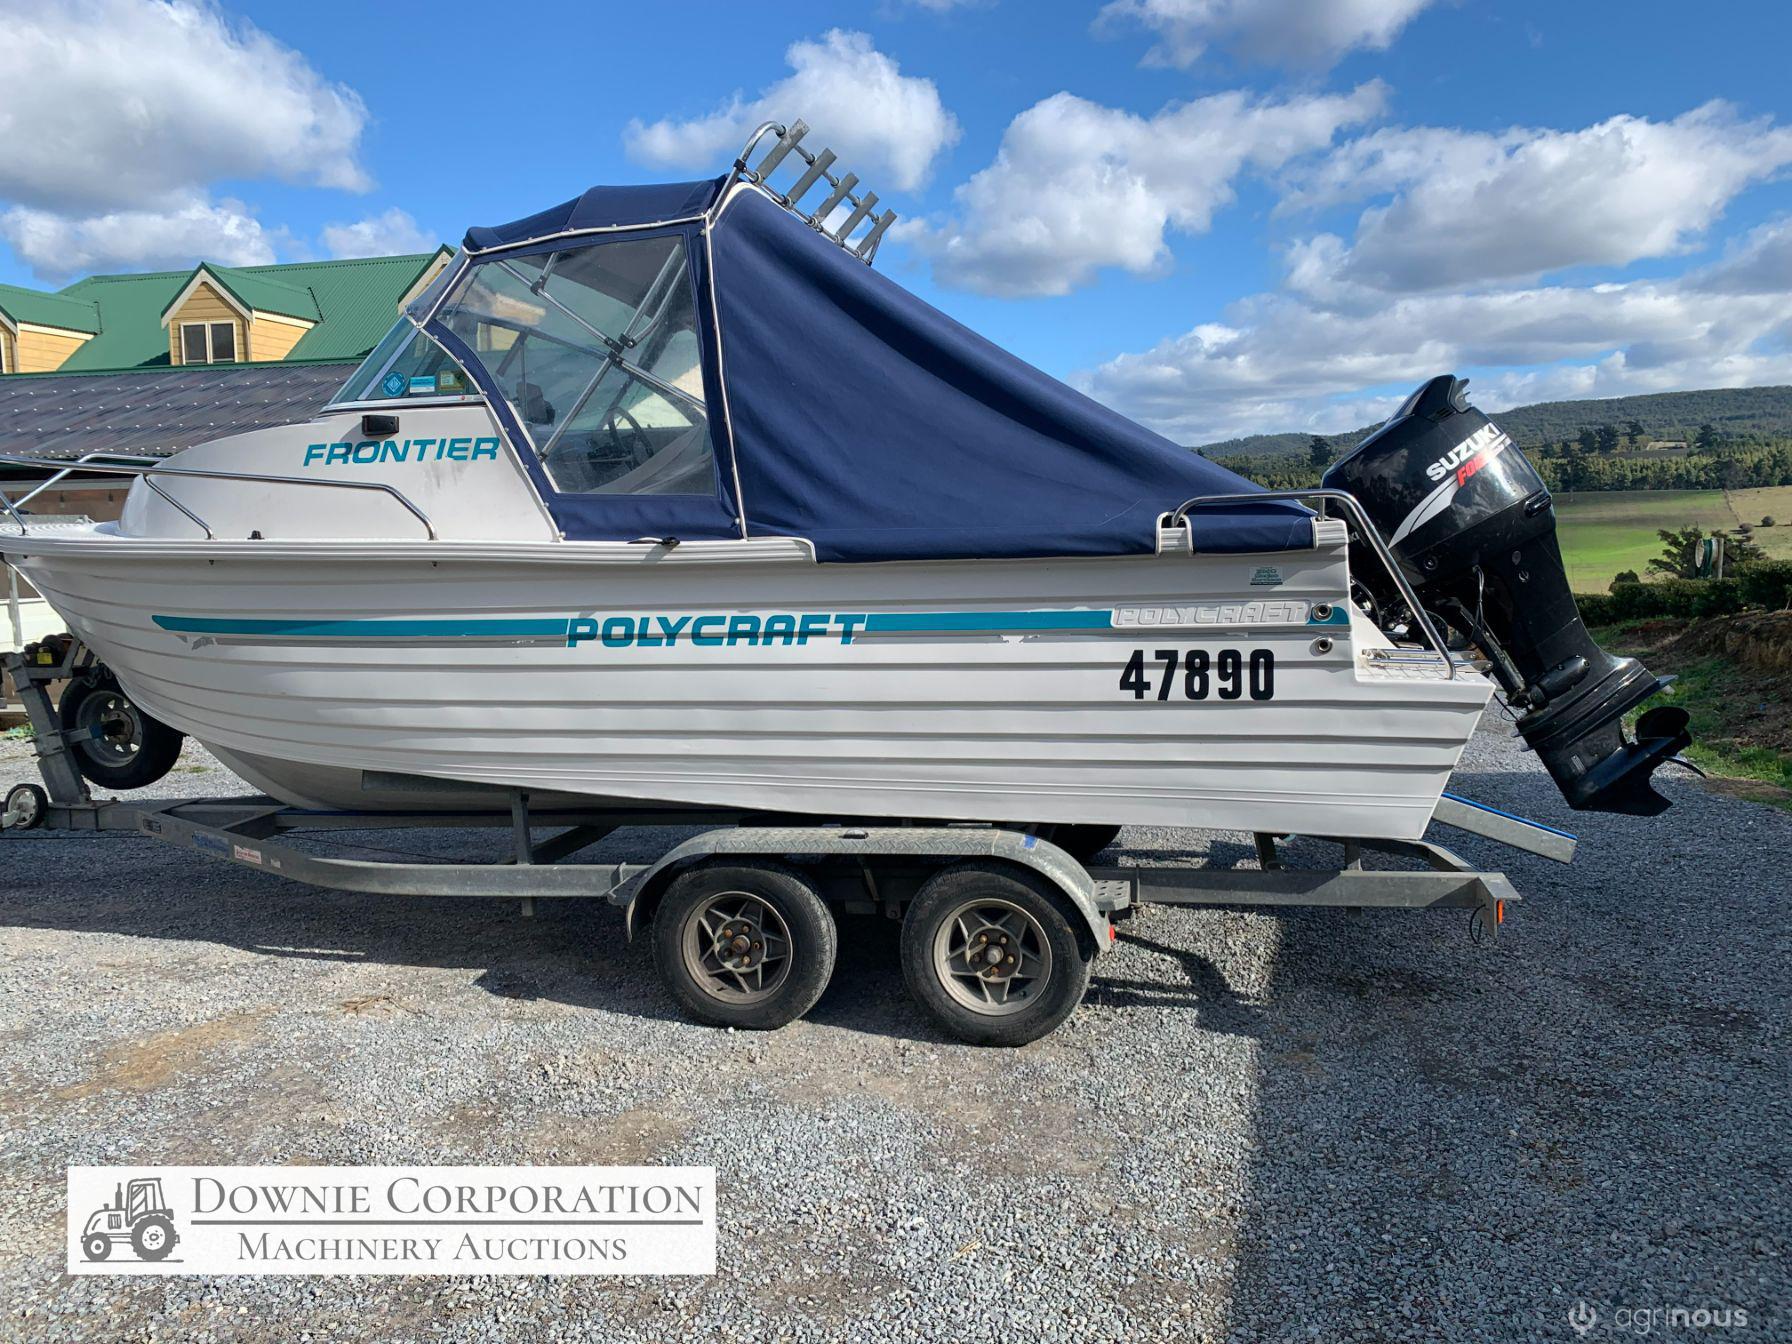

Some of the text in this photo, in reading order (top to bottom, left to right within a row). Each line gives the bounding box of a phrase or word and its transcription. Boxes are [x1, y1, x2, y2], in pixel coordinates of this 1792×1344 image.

[303, 437, 500, 466] FRONTIER
[1426, 422, 1501, 481] SUZUKI
[1117, 602, 1305, 625] POLYCRAFT
[567, 614, 867, 647] POLYCRAFT
[1119, 649, 1275, 700] 47890
